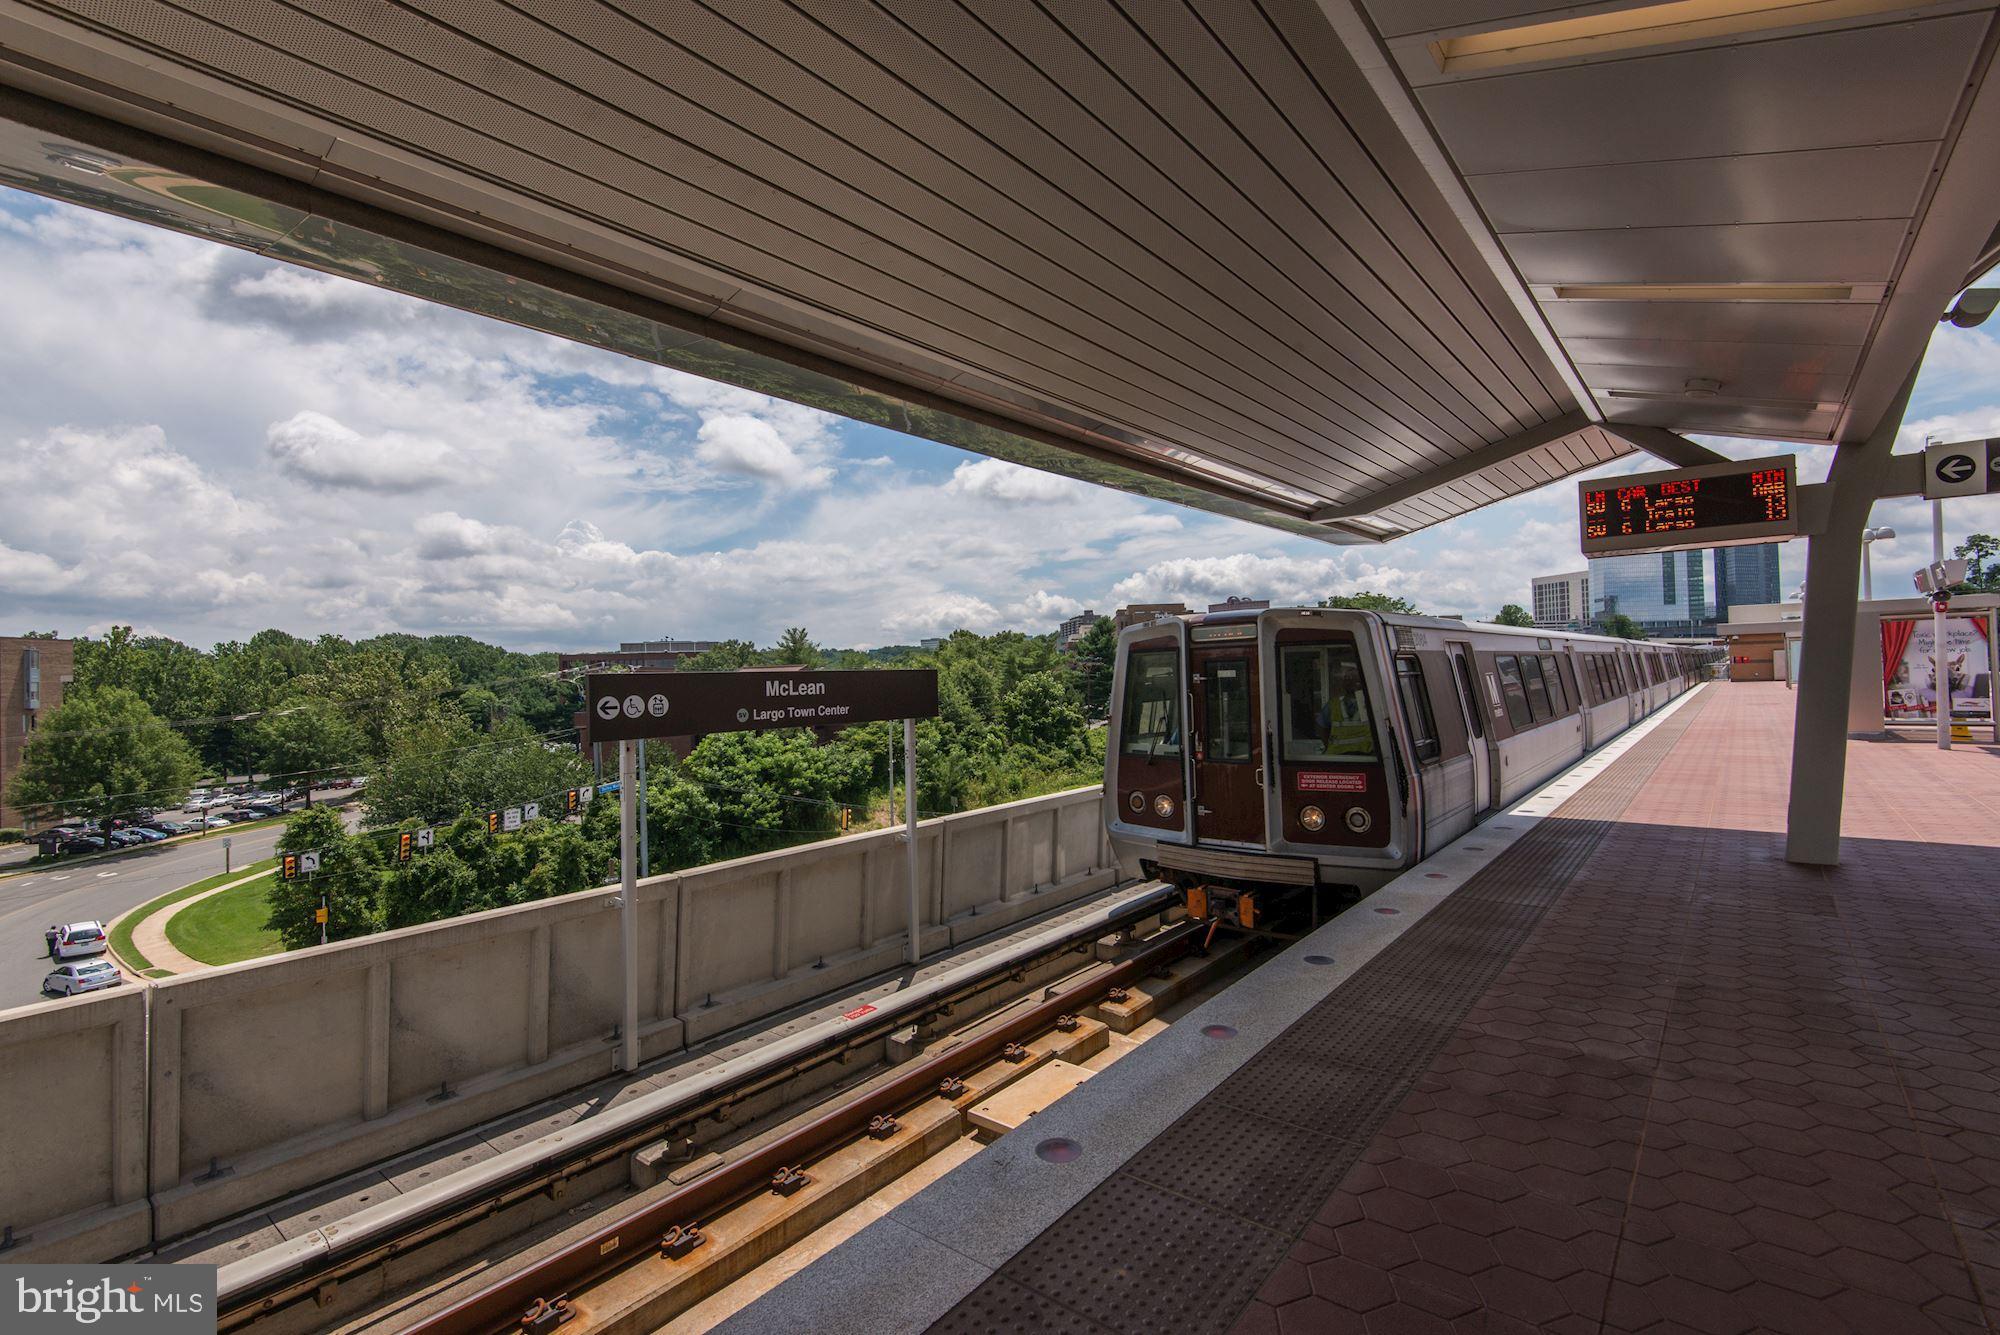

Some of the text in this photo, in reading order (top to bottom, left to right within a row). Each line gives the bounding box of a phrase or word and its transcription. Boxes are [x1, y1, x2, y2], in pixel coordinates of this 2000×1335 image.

[1617, 485, 1646, 500] CAR
[1661, 479, 1701, 496] DEST
[1752, 469, 1785, 484] MIN
[1646, 507, 1694, 520] Train
[765, 680, 826, 697] McLean
[753, 709, 785, 723] Largo
[787, 706, 815, 718] Town
[817, 704, 850, 716] Center
